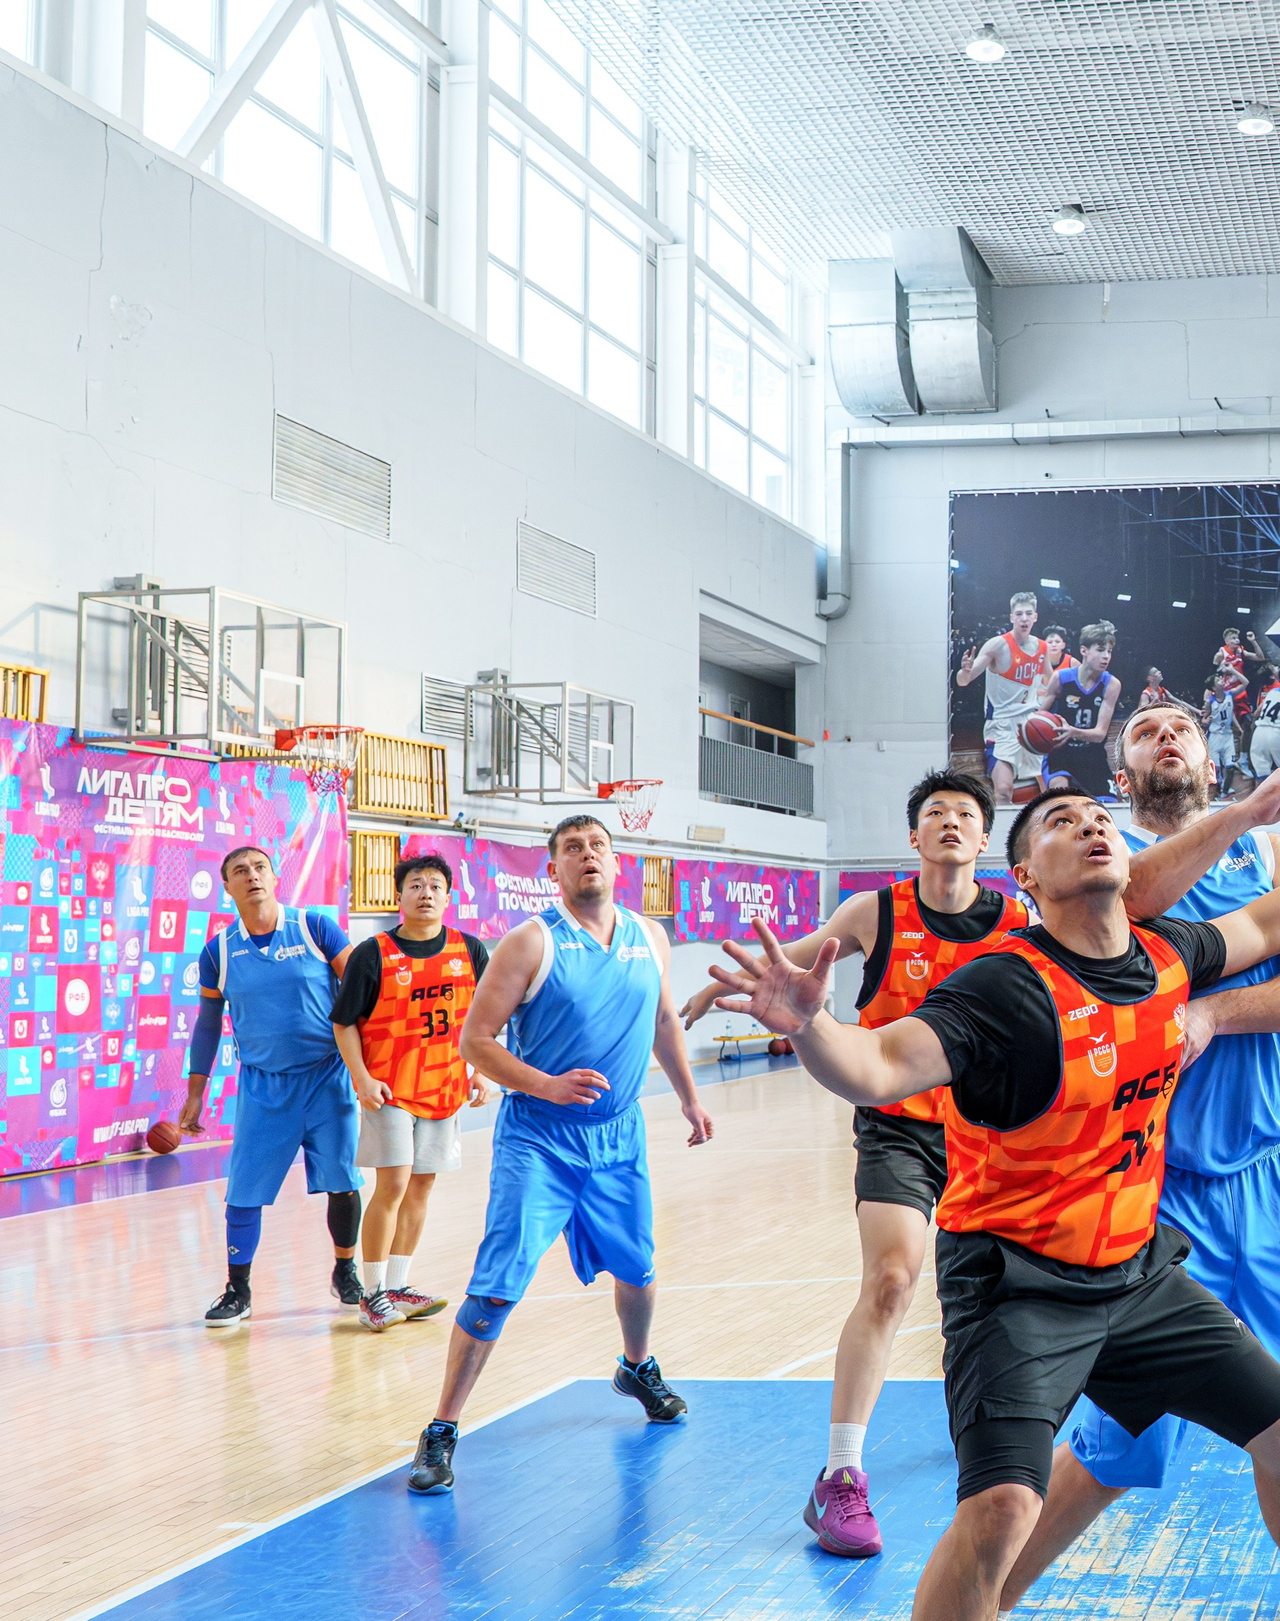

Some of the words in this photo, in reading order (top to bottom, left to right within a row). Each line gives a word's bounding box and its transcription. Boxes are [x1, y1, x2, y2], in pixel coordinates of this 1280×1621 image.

[1015, 662, 1040, 680] ЦСК
[1075, 708, 1092, 729] 13
[104, 796, 204, 832] ДЕТЯМ
[495, 871, 560, 895] ФЕСТИВАЛЬ
[739, 902, 779, 925] ДЕТЯМ
[901, 931, 925, 939] ZEDO
[420, 1008, 450, 1039] 33
[1067, 1003, 1099, 1022] ZEDO
